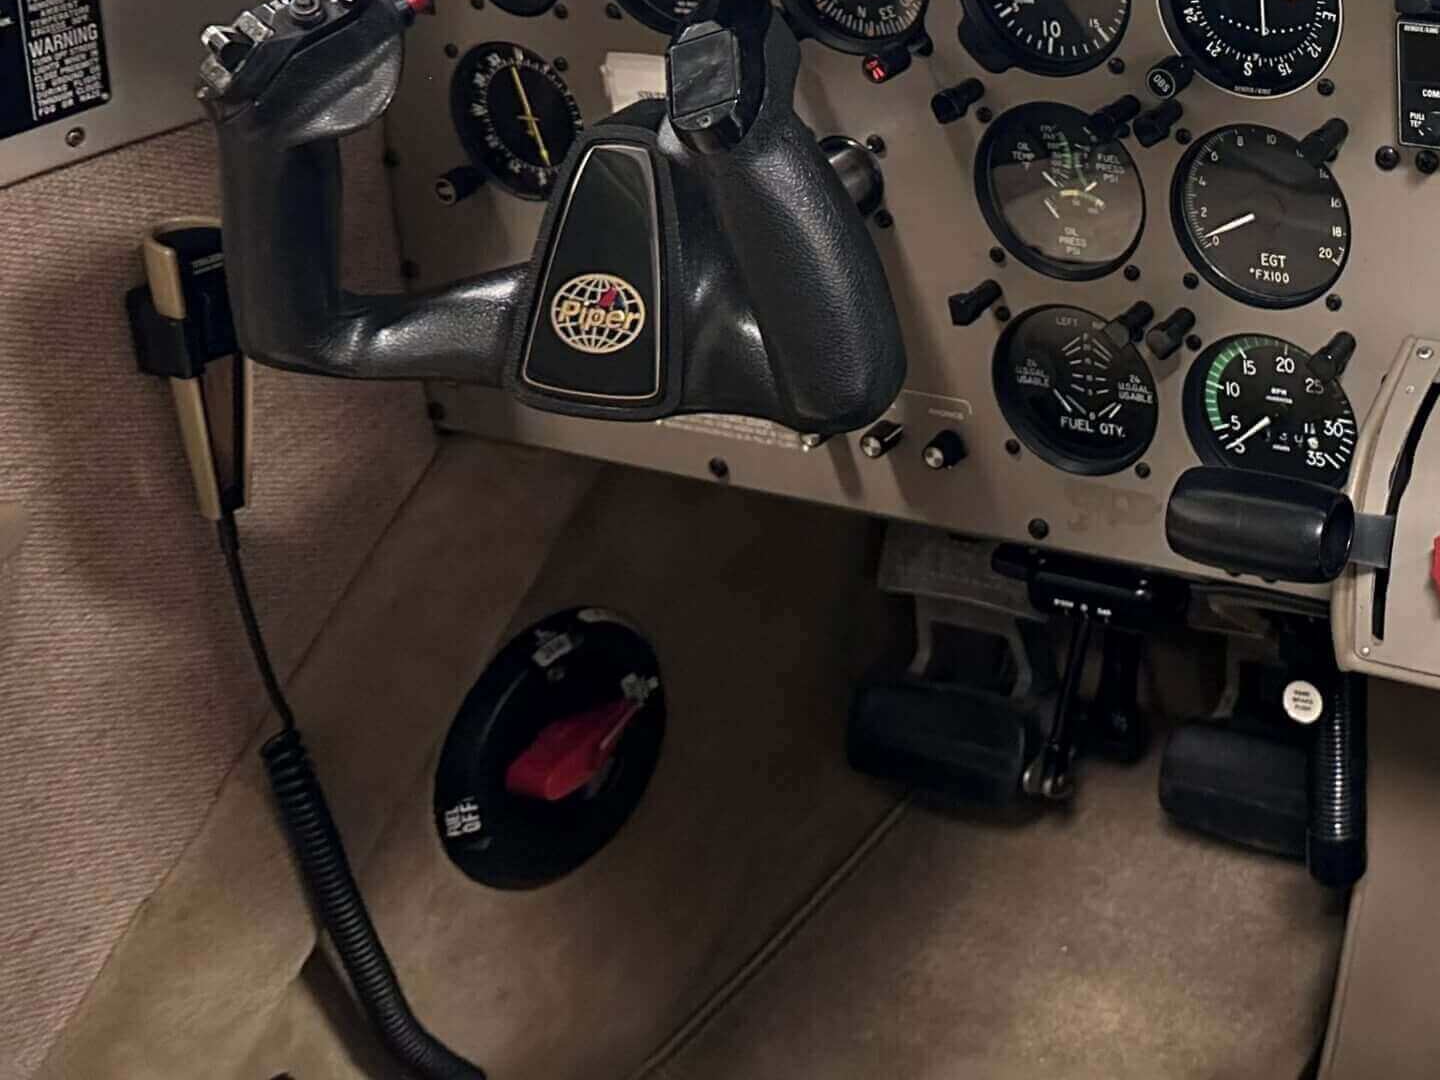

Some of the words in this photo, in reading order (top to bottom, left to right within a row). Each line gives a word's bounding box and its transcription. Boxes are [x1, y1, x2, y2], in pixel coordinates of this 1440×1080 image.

[1042, 21, 1061, 37] 10
[28, 23, 98, 58] WARNING
[1153, 75, 1169, 92] OBS
[1098, 154, 1120, 164] FUEL
[1096, 163, 1124, 174] PRESS
[1103, 174, 1118, 183] PSI
[1064, 227, 1078, 235] OIL
[1059, 237, 1086, 247] PRESS
[1066, 246, 1081, 255] PSI
[1319, 248, 1332, 259] 20
[1260, 254, 1286, 267] EGT
[558, 300, 640, 330] Piper
[1056, 318, 1077, 326] LEFT
[1243, 360, 1256, 375] 15
[1275, 357, 1295, 373] 20
[1017, 376, 1049, 386] USABLE
[1305, 378, 1324, 394] 25
[1226, 382, 1240, 397] 10
[1119, 392, 1152, 403] USABLE
[1061, 416, 1094, 432] FUEL
[1100, 423, 1126, 438] QTY.
[1324, 420, 1343, 437] 30
[1306, 451, 1325, 467] 35
[460, 796, 481, 833] OFF
